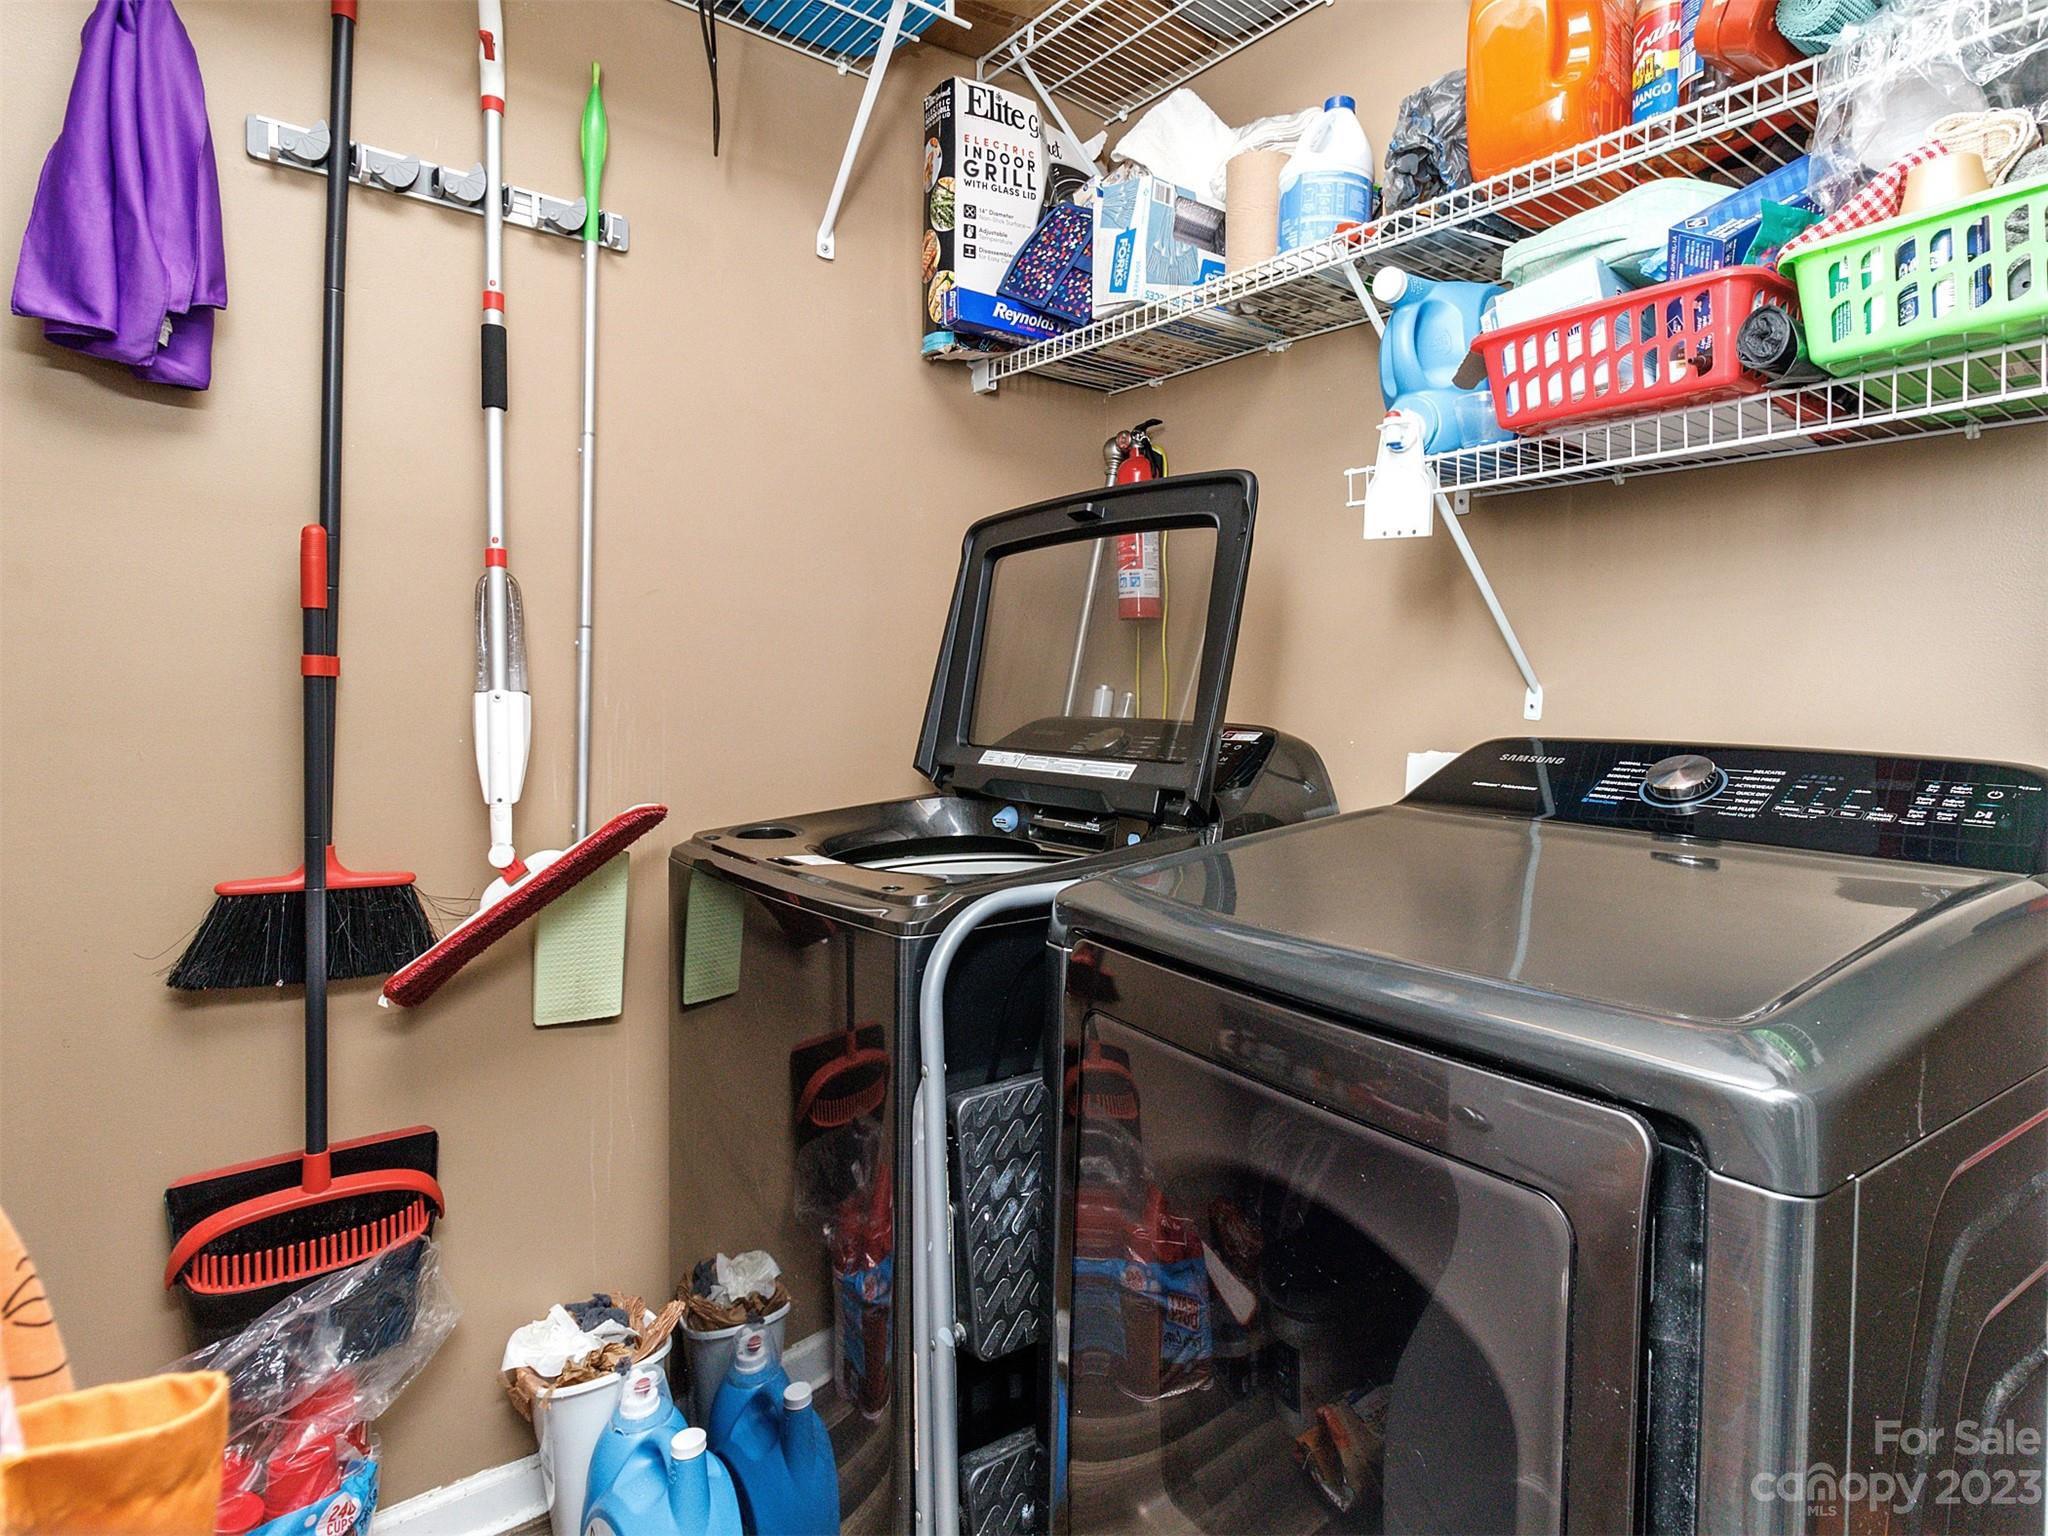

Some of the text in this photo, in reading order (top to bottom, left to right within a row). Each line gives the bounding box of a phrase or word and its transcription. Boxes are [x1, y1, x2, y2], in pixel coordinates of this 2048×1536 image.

[964, 84, 1026, 130] Elite
[964, 133, 1035, 160] ELECTRIC
[964, 144, 1036, 173] INDOOR
[963, 159, 1037, 191] GRILL
[963, 178, 1037, 200] WITH GLASS LID
[989, 209, 1014, 219] Diameter
[979, 228, 1008, 238] Adjustable
[1115, 238, 1128, 288] FORKS
[992, 302, 1055, 332] Reynolds
[1499, 754, 1565, 764] SAMSUNG
[328, 1502, 356, 1523] 240
[326, 1516, 355, 1536] CUPS
